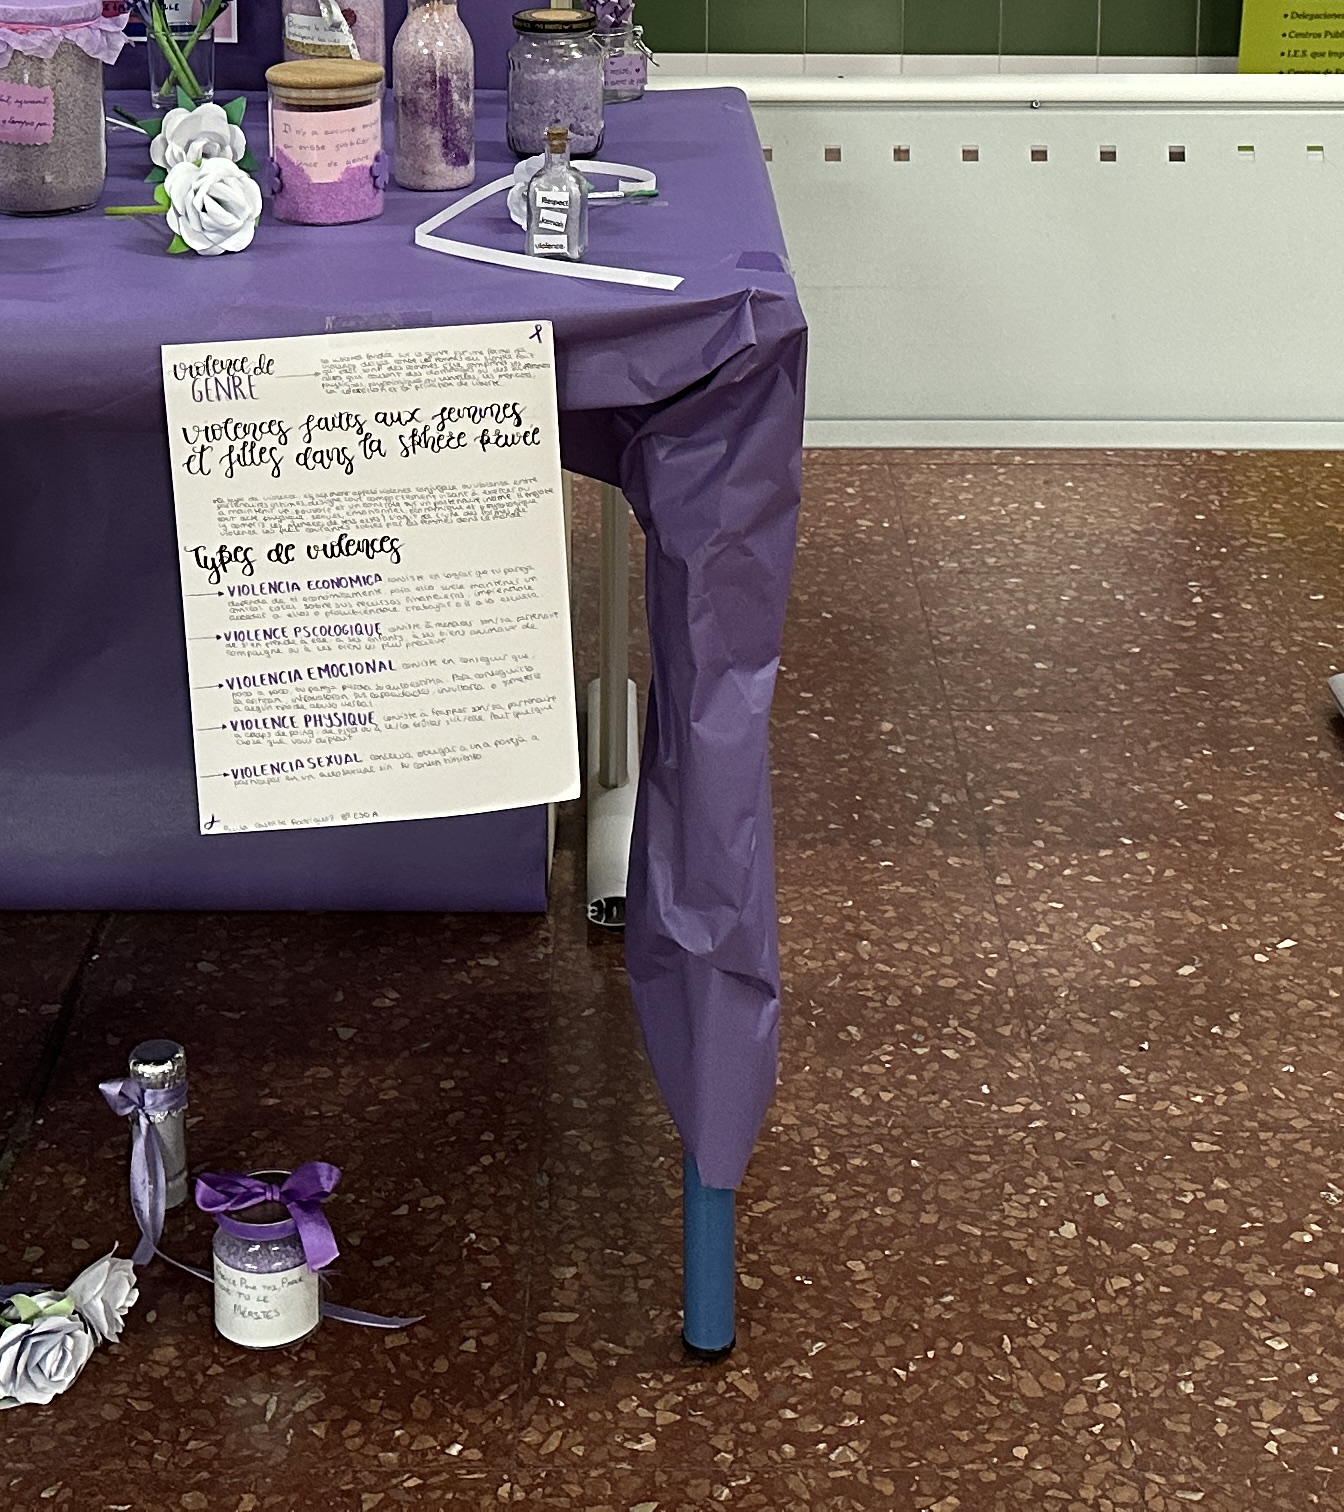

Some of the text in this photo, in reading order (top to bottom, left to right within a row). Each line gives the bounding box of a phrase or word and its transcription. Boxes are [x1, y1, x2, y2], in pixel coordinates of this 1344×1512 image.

[253, 353, 275, 376] de
[191, 375, 259, 403] GENRE
[182, 416, 293, 446] violences
[374, 405, 423, 424] aux
[182, 443, 212, 477] et
[296, 445, 355, 475] dans
[358, 430, 387, 460] la
[267, 541, 296, 565] de
[227, 580, 301, 598] VIOLENCIA
[223, 626, 288, 643] VIOLENCE
[225, 659, 397, 690] VIOLENCIA EMOCIONAL
[229, 710, 376, 732] VIOLENCE PHYSIQUE
[230, 752, 364, 781] VIOLENCIA SEXUAL
